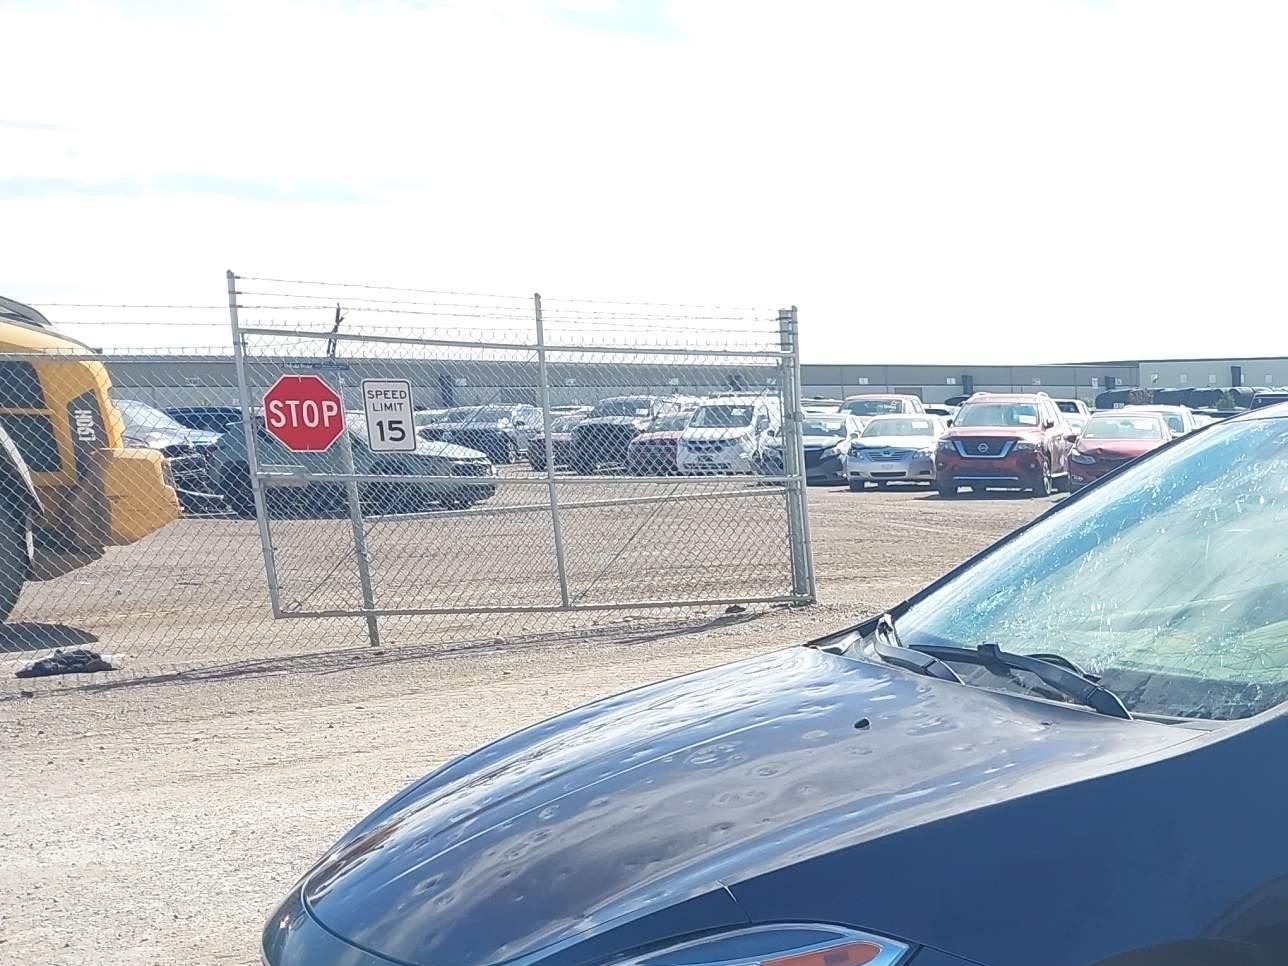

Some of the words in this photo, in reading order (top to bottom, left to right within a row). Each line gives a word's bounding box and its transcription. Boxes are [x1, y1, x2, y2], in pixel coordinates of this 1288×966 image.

[367, 390, 407, 399] SPEED
[269, 400, 338, 428] STOP
[373, 403, 404, 411] LIMIT
[376, 420, 406, 442] 15
